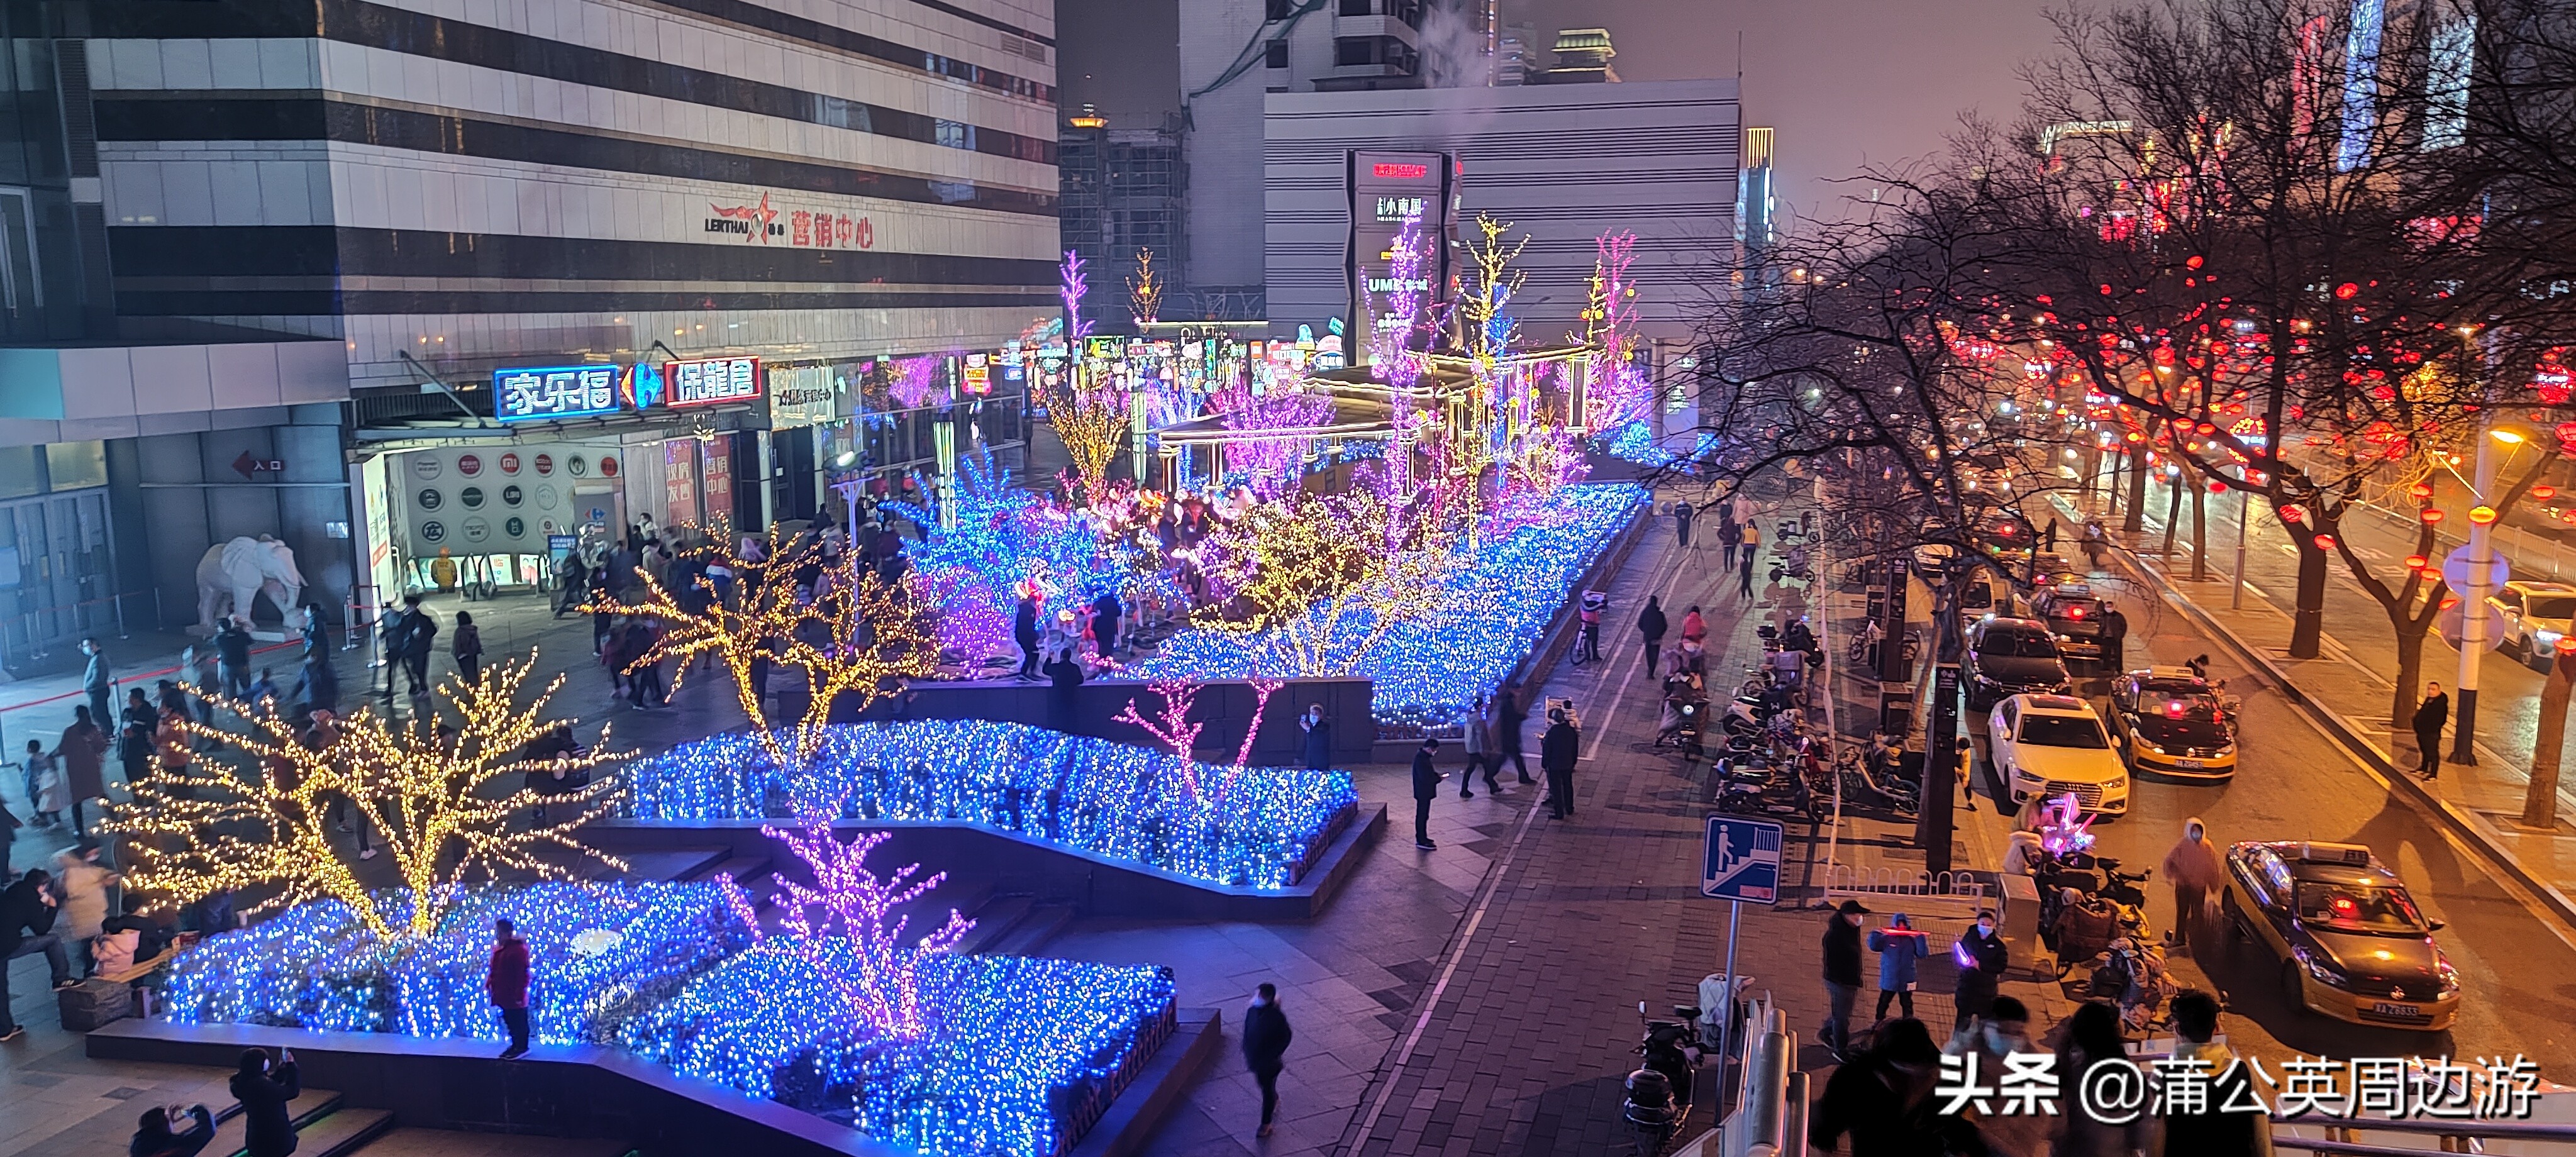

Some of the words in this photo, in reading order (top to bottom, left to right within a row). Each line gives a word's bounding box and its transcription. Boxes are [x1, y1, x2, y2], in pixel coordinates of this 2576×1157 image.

[792, 210, 873, 249] 营销中心
[504, 370, 611, 415] 家乐福
[253, 460, 282, 470] 入口
[667, 462, 689, 480] 现房
[706, 456, 728, 475] 营销
[668, 482, 690, 502] 发售
[707, 478, 728, 495] 中心
